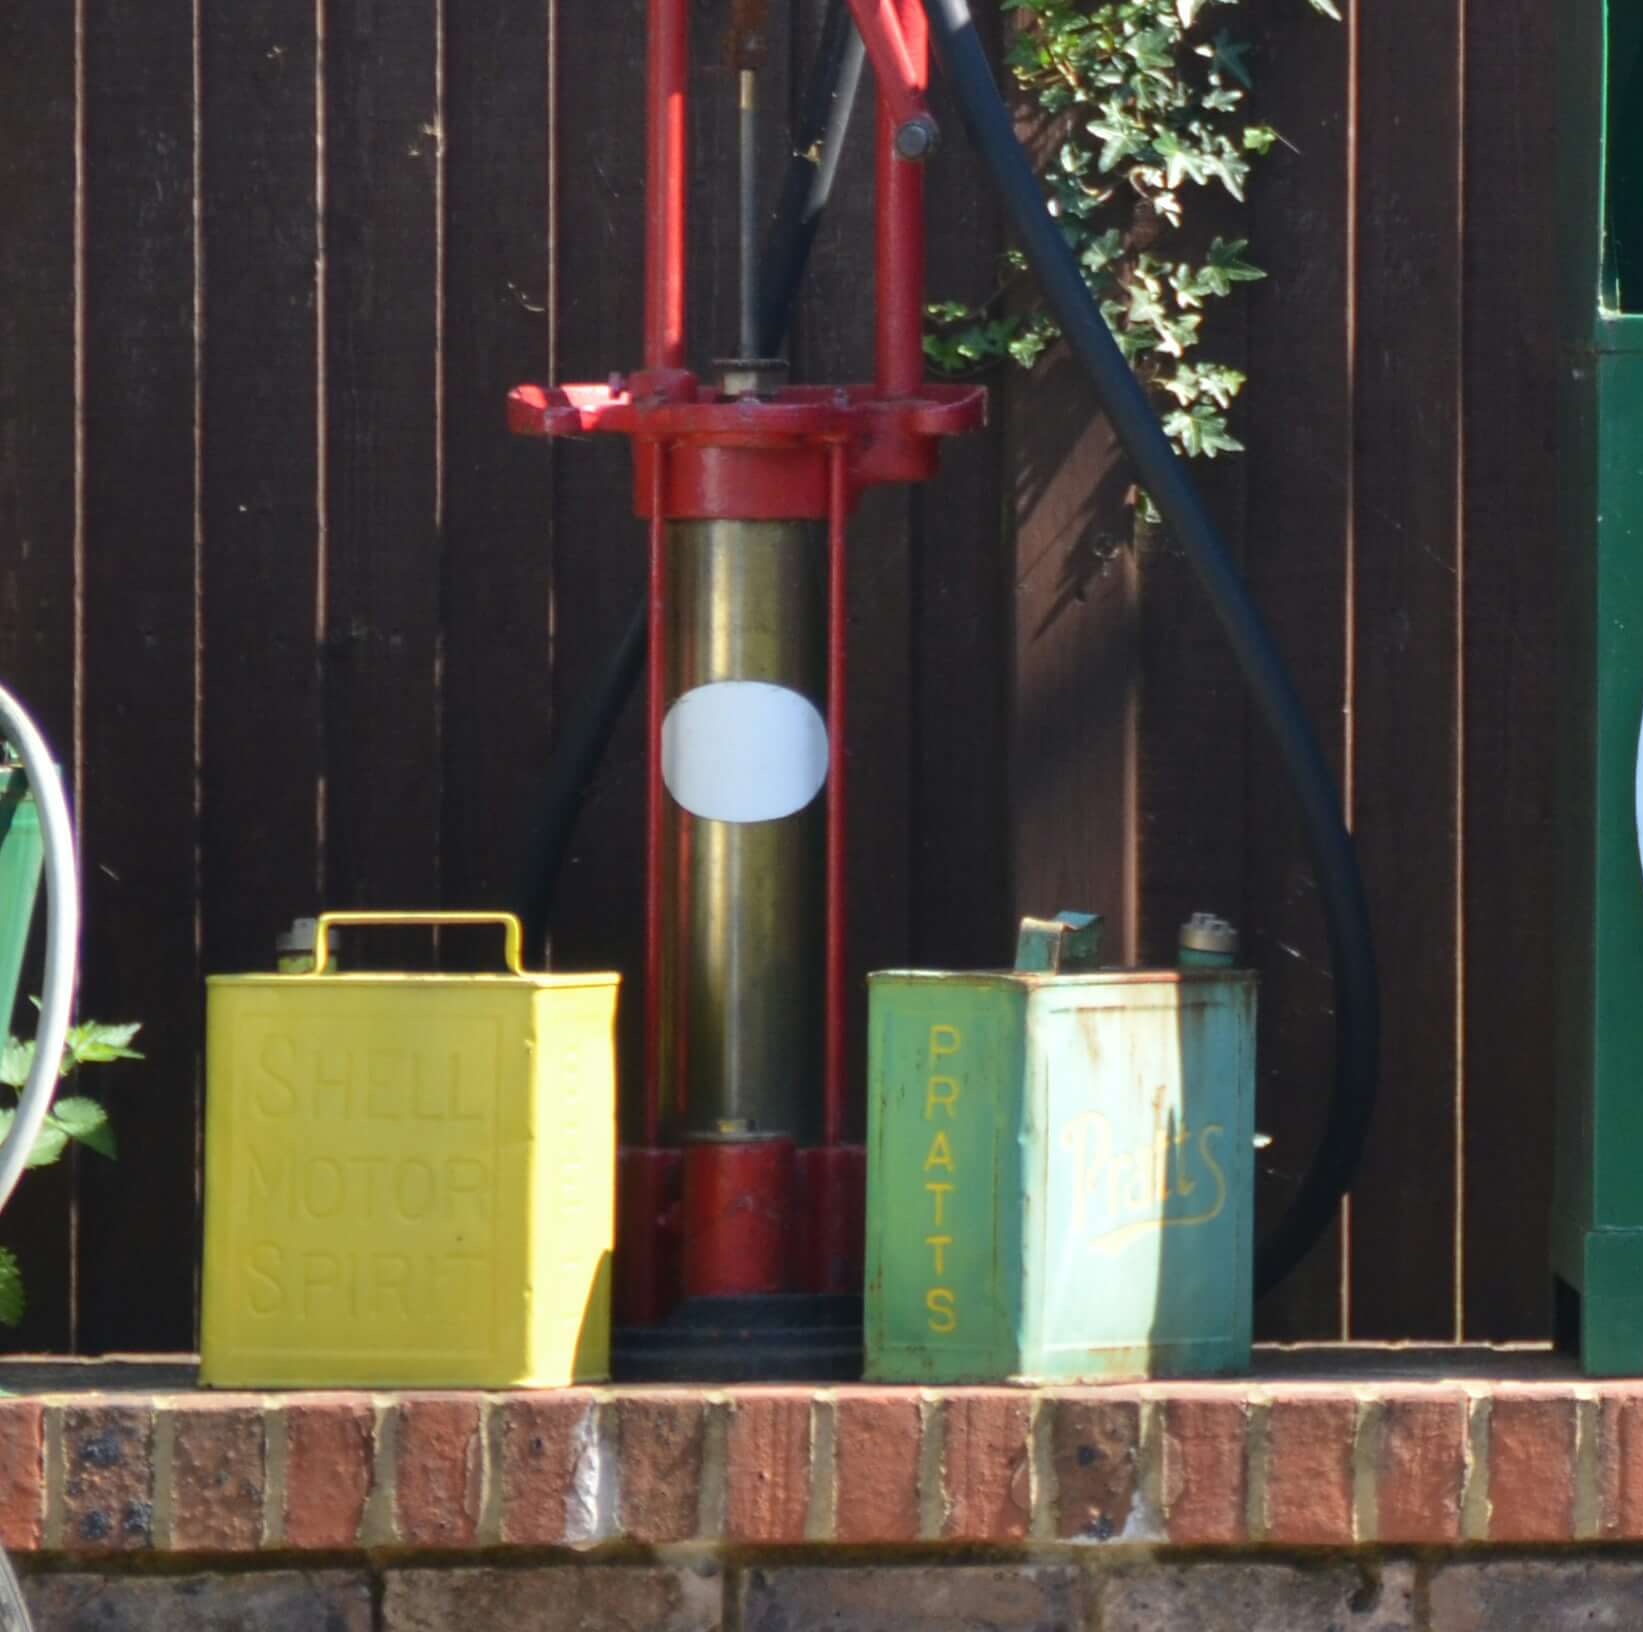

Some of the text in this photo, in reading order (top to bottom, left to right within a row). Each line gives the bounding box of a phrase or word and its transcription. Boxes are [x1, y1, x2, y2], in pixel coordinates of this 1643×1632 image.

[254, 1032, 486, 1122] SHELL
[248, 1144, 490, 1225] MOTOR
[922, 1023, 962, 1334] PRATTS
